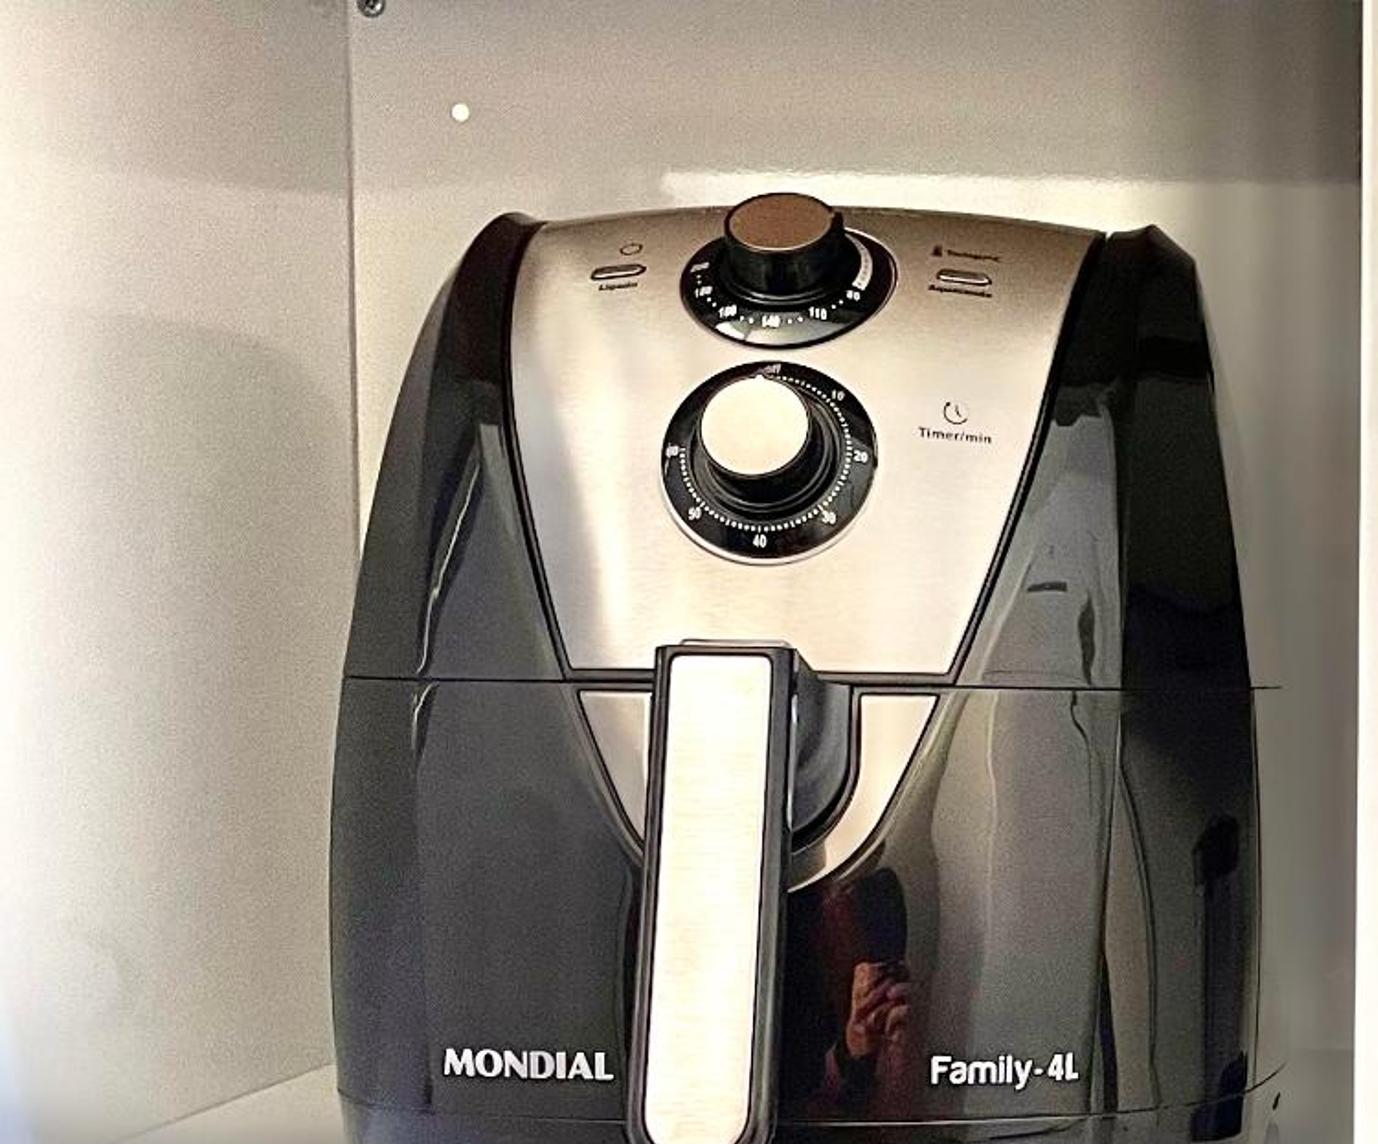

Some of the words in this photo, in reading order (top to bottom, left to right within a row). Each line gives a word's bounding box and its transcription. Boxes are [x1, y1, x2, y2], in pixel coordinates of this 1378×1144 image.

[919, 426, 992, 444] Timer/min
[853, 450, 869, 463] 20
[688, 507, 701, 521] 50
[753, 535, 767, 549] 40
[443, 1047, 615, 1081] MONDIAL
